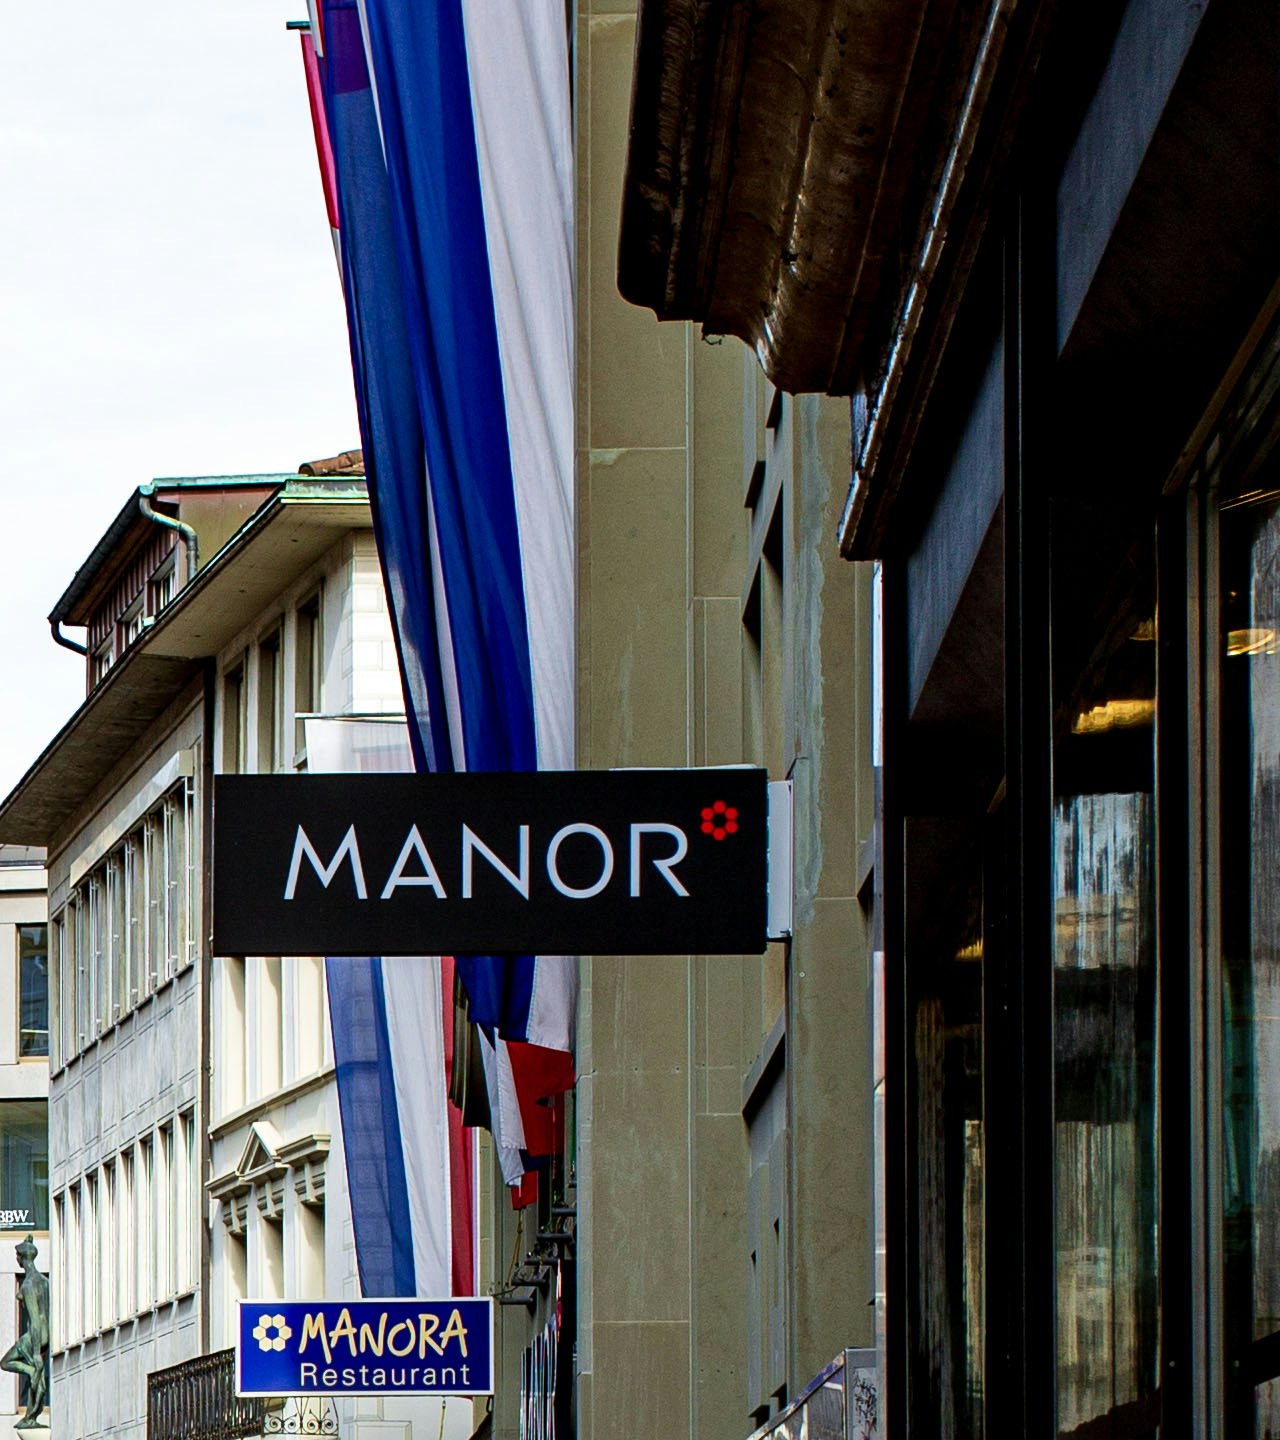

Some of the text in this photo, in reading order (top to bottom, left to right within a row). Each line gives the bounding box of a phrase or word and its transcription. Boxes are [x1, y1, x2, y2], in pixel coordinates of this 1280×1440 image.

[283, 821, 691, 901] MANOR
[298, 1307, 469, 1365] MANORA
[299, 1362, 471, 1387] Restaurant
